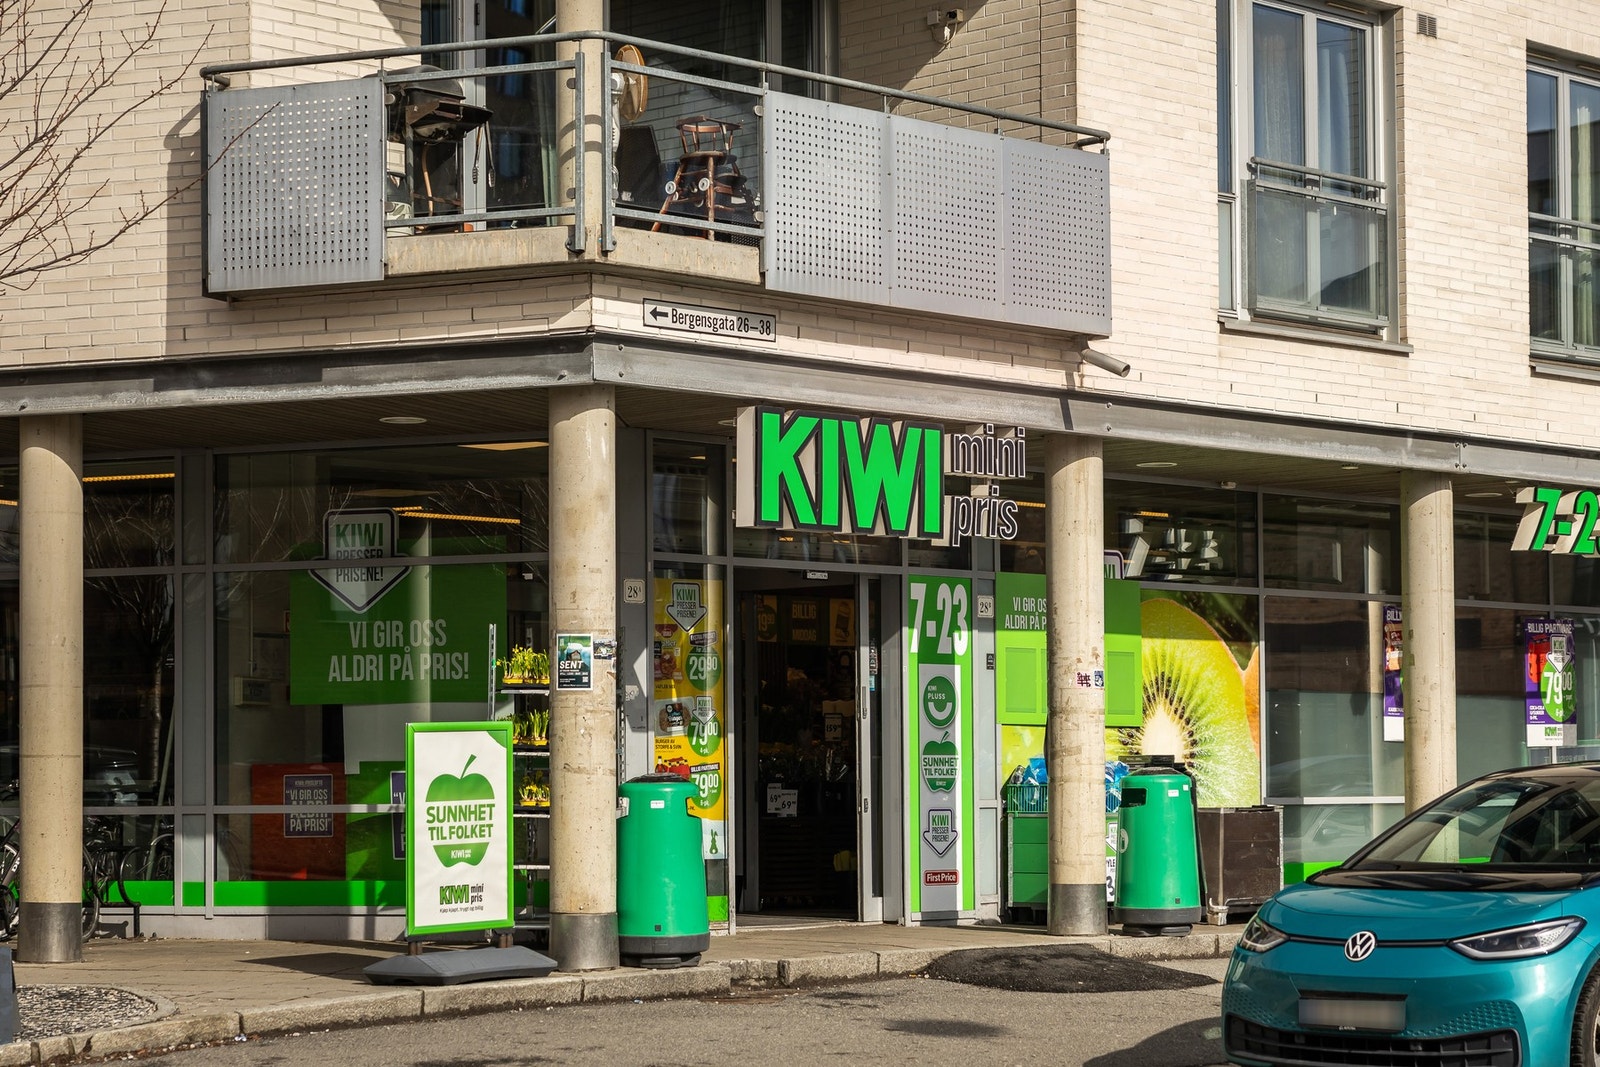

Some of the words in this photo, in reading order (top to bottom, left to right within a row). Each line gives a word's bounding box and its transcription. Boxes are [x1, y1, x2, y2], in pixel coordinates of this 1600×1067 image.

[671, 308, 735, 332] Bergensgata
[953, 423, 1026, 478] mini
[757, 407, 944, 538] KIWI
[952, 485, 1018, 547] pris
[1530, 486, 1600, 555] 7-2
[336, 522, 384, 548] KIWI
[676, 588, 696, 601] KIWI
[676, 601, 697, 609] PRESSER
[792, 603, 817, 619] BILLIG
[1012, 596, 1021, 611] VI
[1022, 597, 1036, 612] GIR
[910, 583, 968, 656] 7-23
[1004, 614, 1028, 630] ALDRI
[1029, 611, 1040, 630] PÅ
[350, 621, 368, 648] VI
[373, 620, 404, 648] GIR
[409, 618, 447, 647] OSS
[1527, 622, 1544, 634] BILLIG
[328, 654, 384, 683] ALDRI
[390, 646, 414, 681] PÅ
[420, 652, 469, 680] PRIS!
[559, 660, 584, 669] SENT
[927, 692, 946, 700] PLUSS
[922, 757, 959, 767] SUNNHET
[923, 768, 934, 776] TIL
[934, 768, 958, 776] FOLKET
[300, 789, 312, 801] GIR
[313, 788, 328, 801] OSS
[426, 803, 496, 824] SUNNHET
[931, 815, 949, 826] KIWI
[428, 826, 447, 841] TIL
[448, 823, 494, 840] FOLKET
[926, 873, 941, 882] First
[941, 873, 957, 882] Price
[439, 884, 470, 905] KIWI
[470, 883, 485, 894] mini
[470, 893, 483, 905] pris
